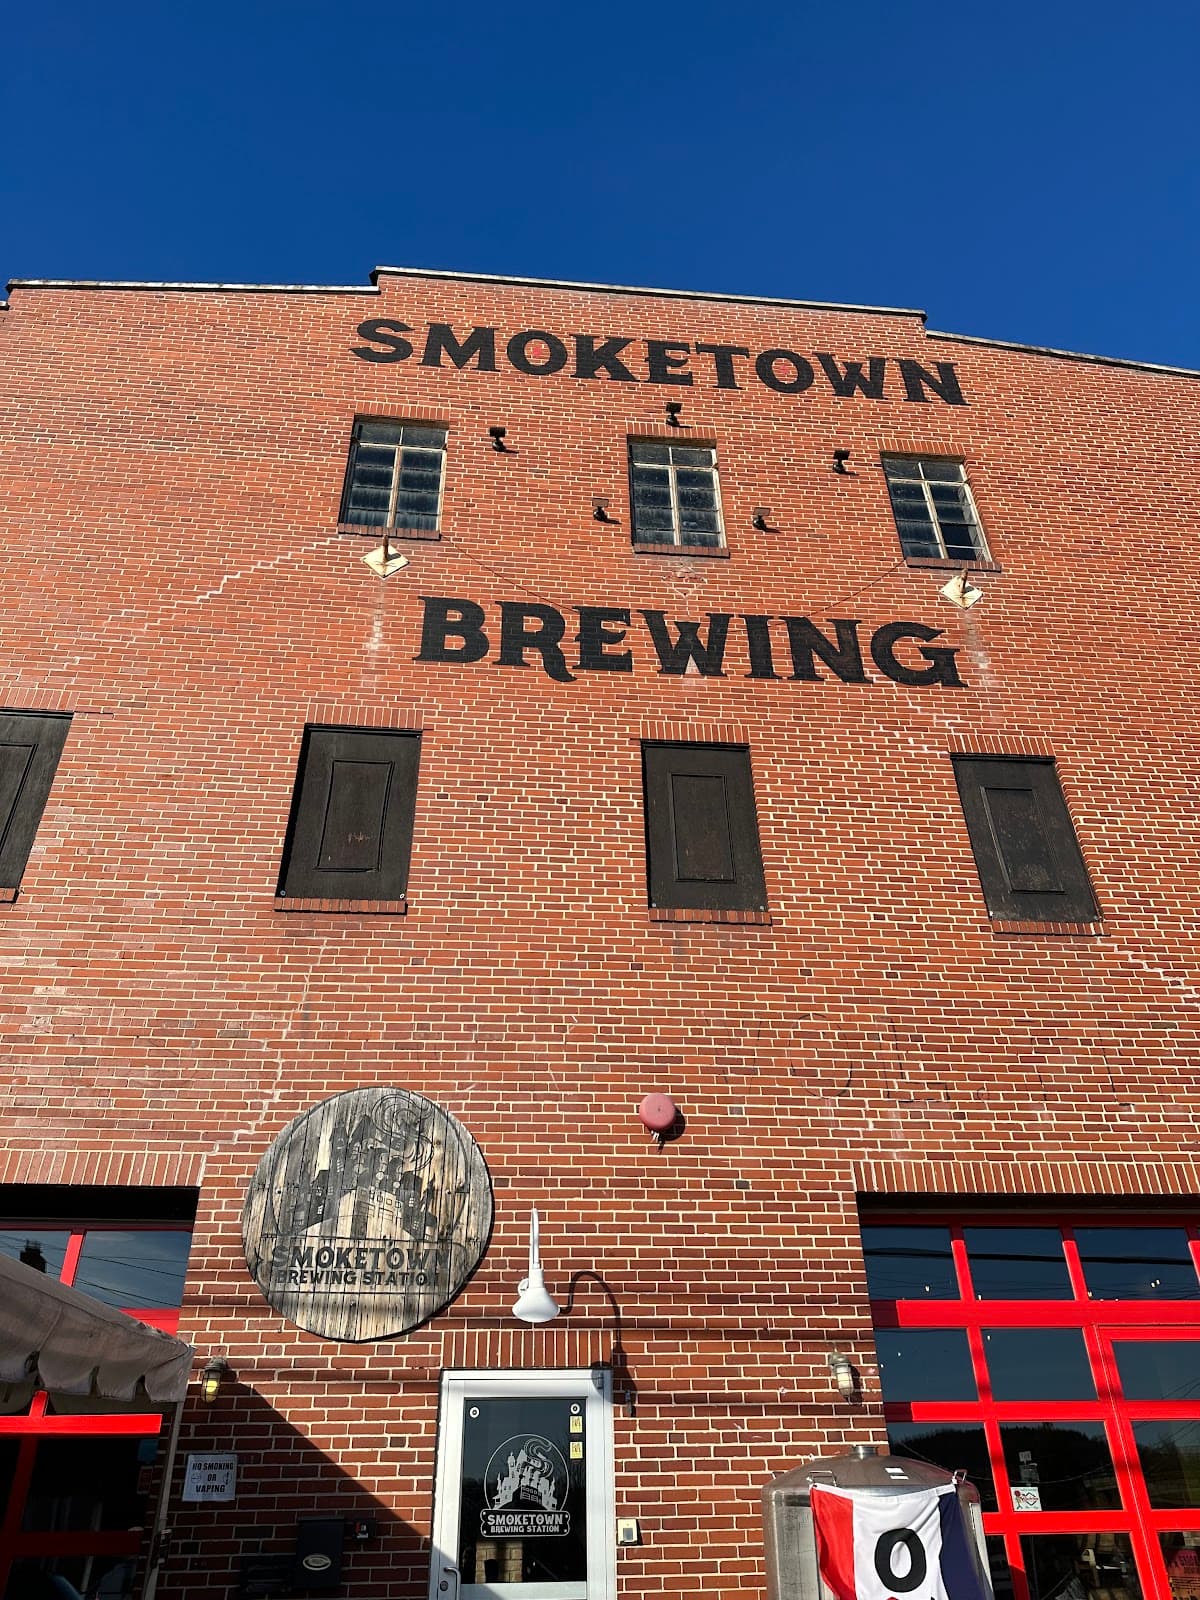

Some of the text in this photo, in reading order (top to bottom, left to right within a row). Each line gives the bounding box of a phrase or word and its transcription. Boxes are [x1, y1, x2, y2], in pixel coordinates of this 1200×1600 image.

[350, 318, 970, 406] SMOKETOWN
[412, 595, 969, 688] BREWING
[272, 1245, 452, 1270] SMOKETOWN
[276, 1269, 439, 1287] BREWING STATION
[192, 1462, 234, 1471] NO SMOKING
[207, 1473, 217, 1482] OR
[195, 1484, 226, 1493] VAPING
[487, 1513, 564, 1526] SMOKETOWN
[490, 1524, 560, 1534] BREWING STATION
